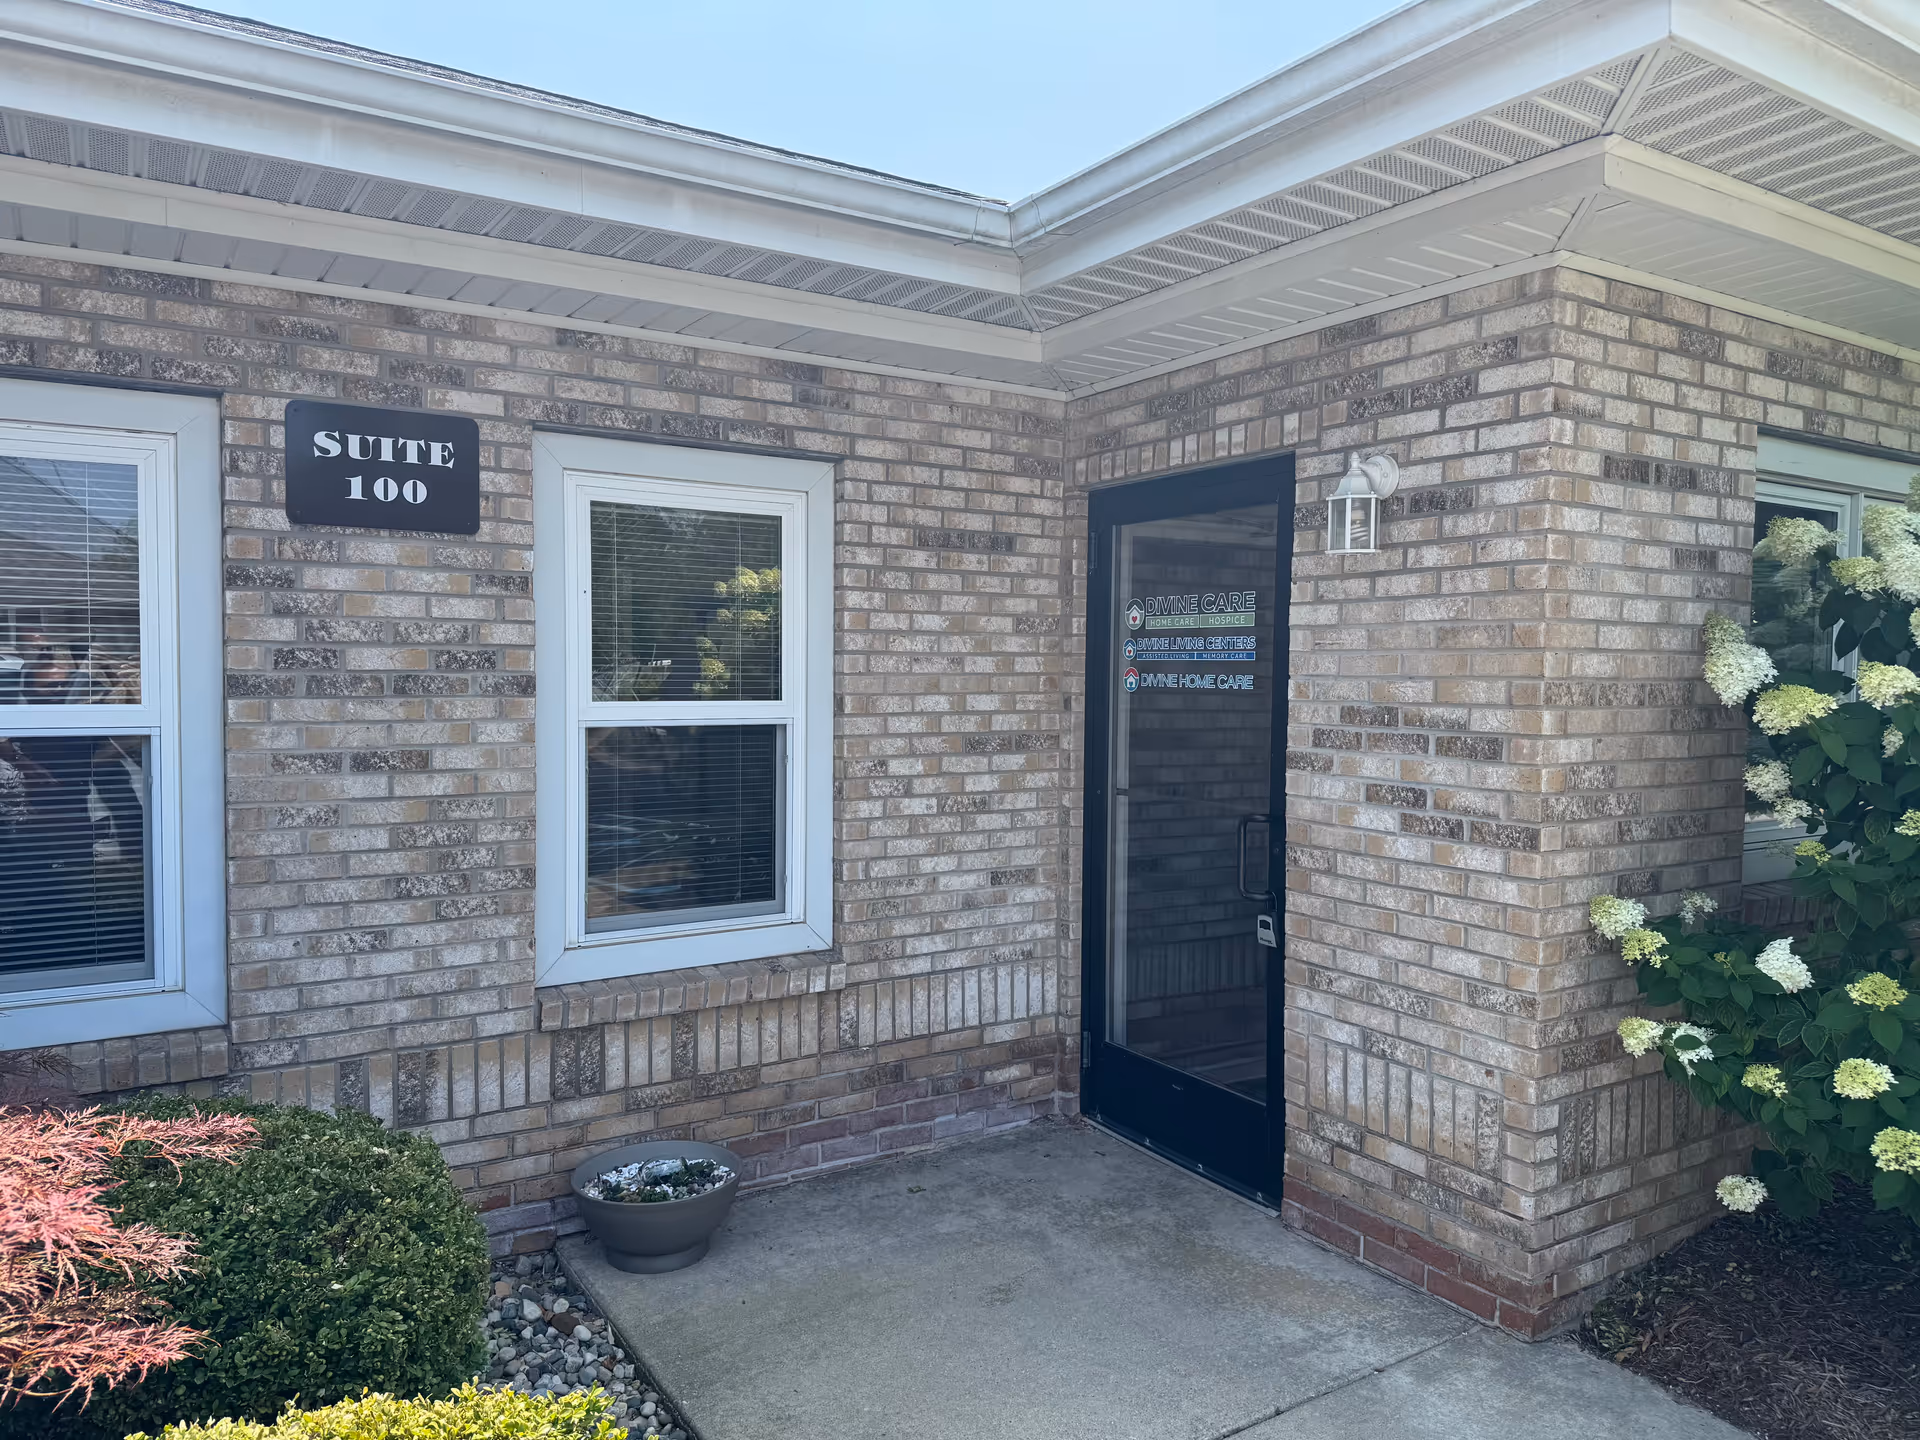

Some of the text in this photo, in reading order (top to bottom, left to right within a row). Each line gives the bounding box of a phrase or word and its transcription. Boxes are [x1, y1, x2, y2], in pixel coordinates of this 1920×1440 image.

[313, 430, 455, 469] SUITE
[344, 475, 428, 504] 100
[1145, 591, 1256, 615] DIVINE CARE
[1150, 618, 1195, 627] HOME CARE
[1208, 615, 1246, 625] HOSPICE
[1137, 636, 1256, 650] DIVINE LIVING CENTERS
[1140, 673, 1254, 690] DIVINE HOME CARE
